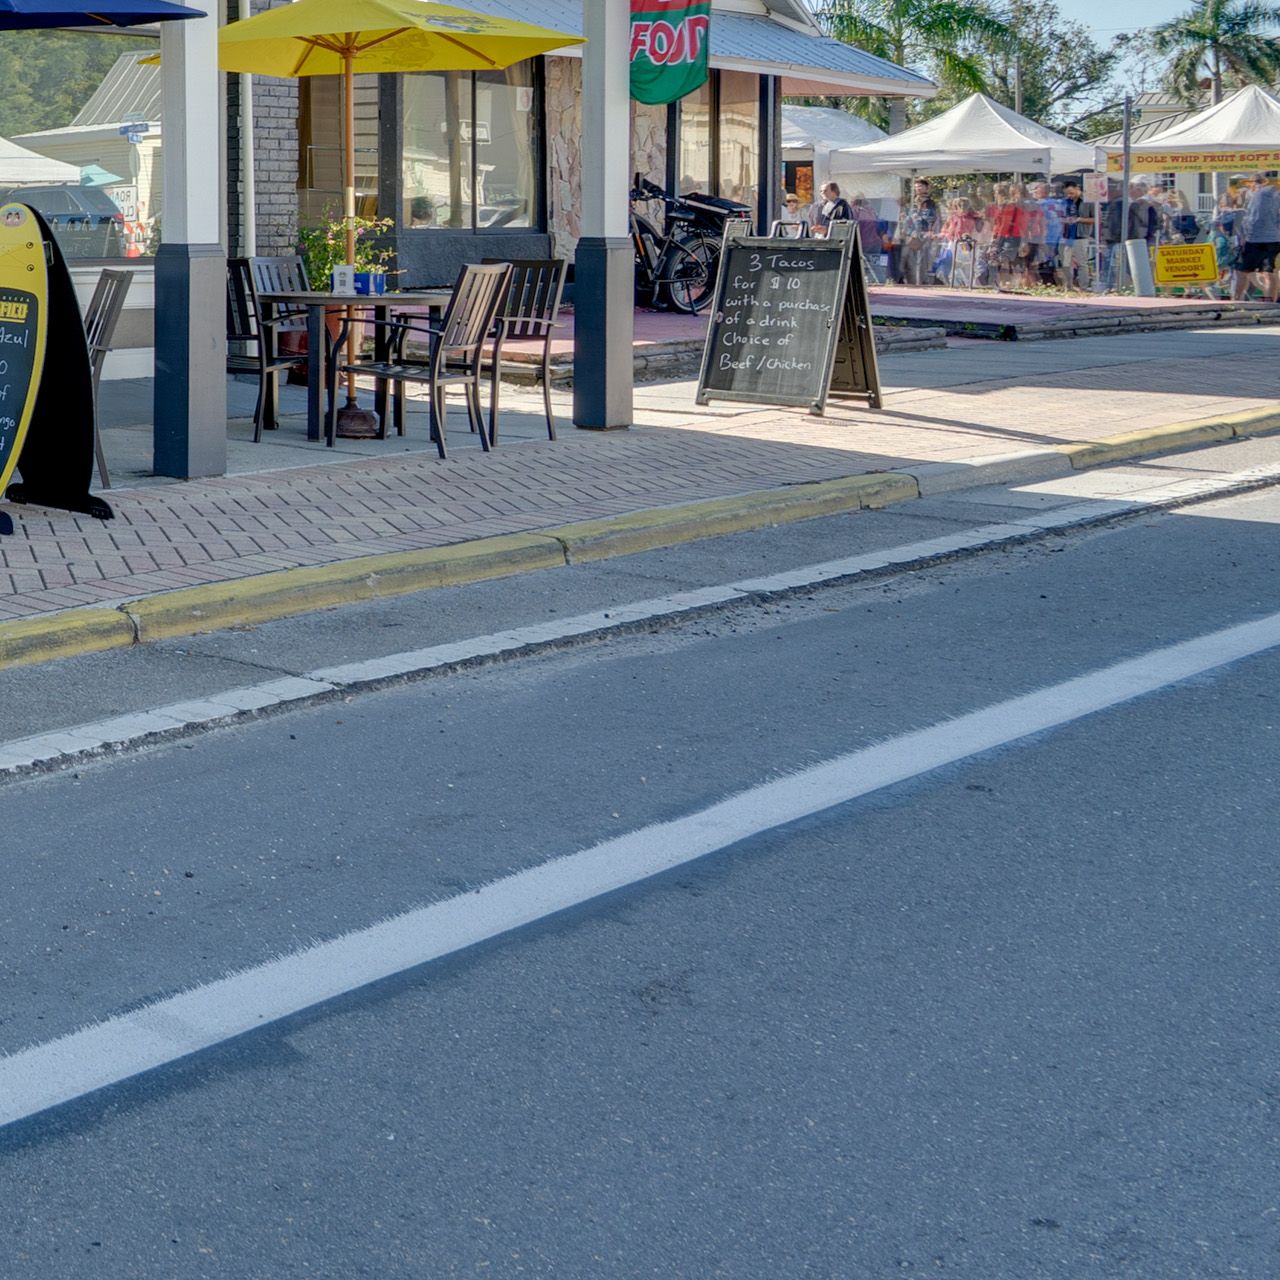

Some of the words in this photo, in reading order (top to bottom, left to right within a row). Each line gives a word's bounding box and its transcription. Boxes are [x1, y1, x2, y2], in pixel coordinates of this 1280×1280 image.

[1136, 155, 1167, 163] DOLE
[1170, 155, 1200, 163] WHIP
[1203, 154, 1236, 163] FRUIT
[1239, 153, 1270, 161] SOFT
[1160, 248, 1205, 257] SATURDAY
[749, 253, 762, 271] 3
[765, 254, 815, 270] Tacos
[1166, 256, 1201, 265] MARKET
[1164, 264, 1206, 272] VENDORS
[732, 275, 756, 289] for
[725, 293, 759, 307] with
[778, 299, 831, 312] purchase
[725, 310, 742, 324] of
[746, 317, 755, 325] a
[759, 314, 799, 328] drink
[722, 331, 770, 346] Choice
[777, 333, 794, 345] of
